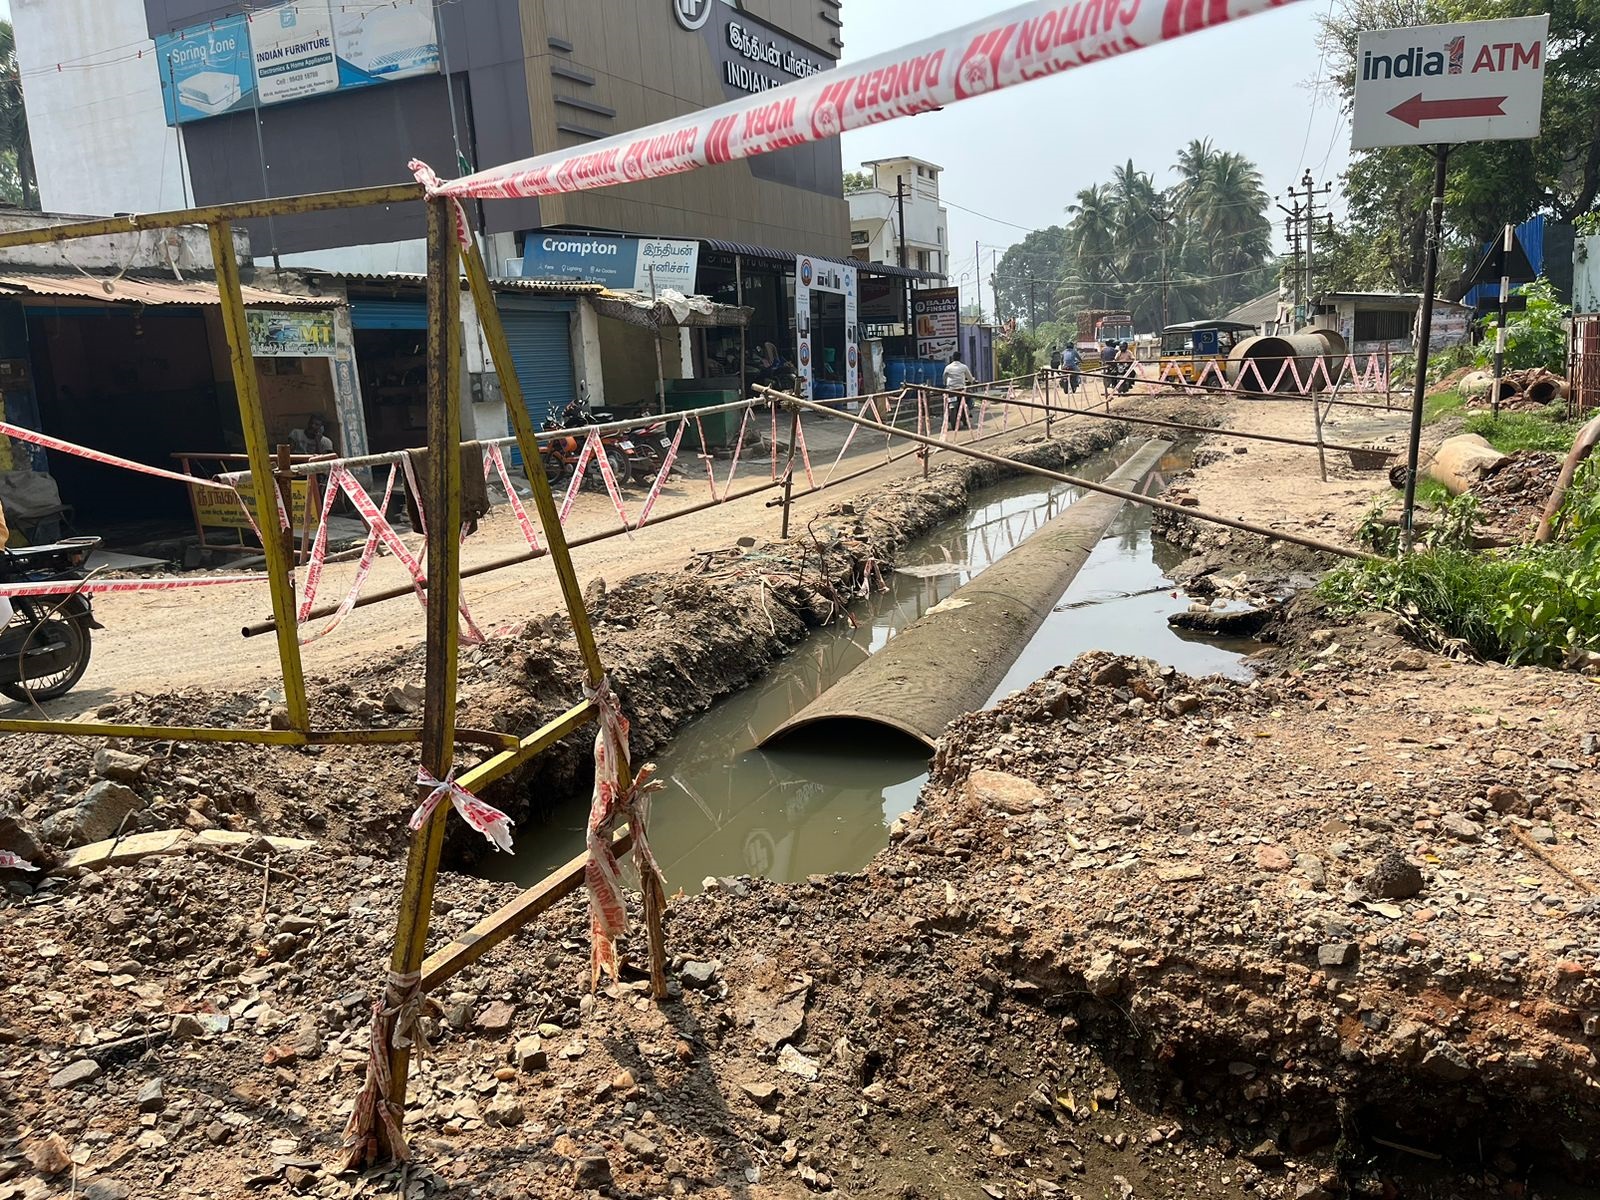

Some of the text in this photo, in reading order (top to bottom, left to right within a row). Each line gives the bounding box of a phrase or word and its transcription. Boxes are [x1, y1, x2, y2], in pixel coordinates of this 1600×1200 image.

[172, 37, 236, 64] Spring Zone
[256, 46, 284, 63] INDIAN
[285, 37, 331, 56] FURNITURE
[729, 22, 780, 68] இந்தியன்
[1363, 36, 1541, 81] india1 ATM
[260, 54, 331, 76] Electronics & Home Appliances
[727, 61, 768, 92] INDIAN
[854, 48, 945, 109] DANGER
[743, 97, 797, 138] WORK
[647, 125, 698, 163] CAUTION
[576, 148, 620, 180] DANGER
[542, 238, 617, 257] Crompton
[642, 243, 693, 257] இந்தியன்
[643, 260, 690, 274] பர்னிச்சர்
[926, 298, 957, 306] BAJAJ
[926, 304, 957, 312] FINSERV
